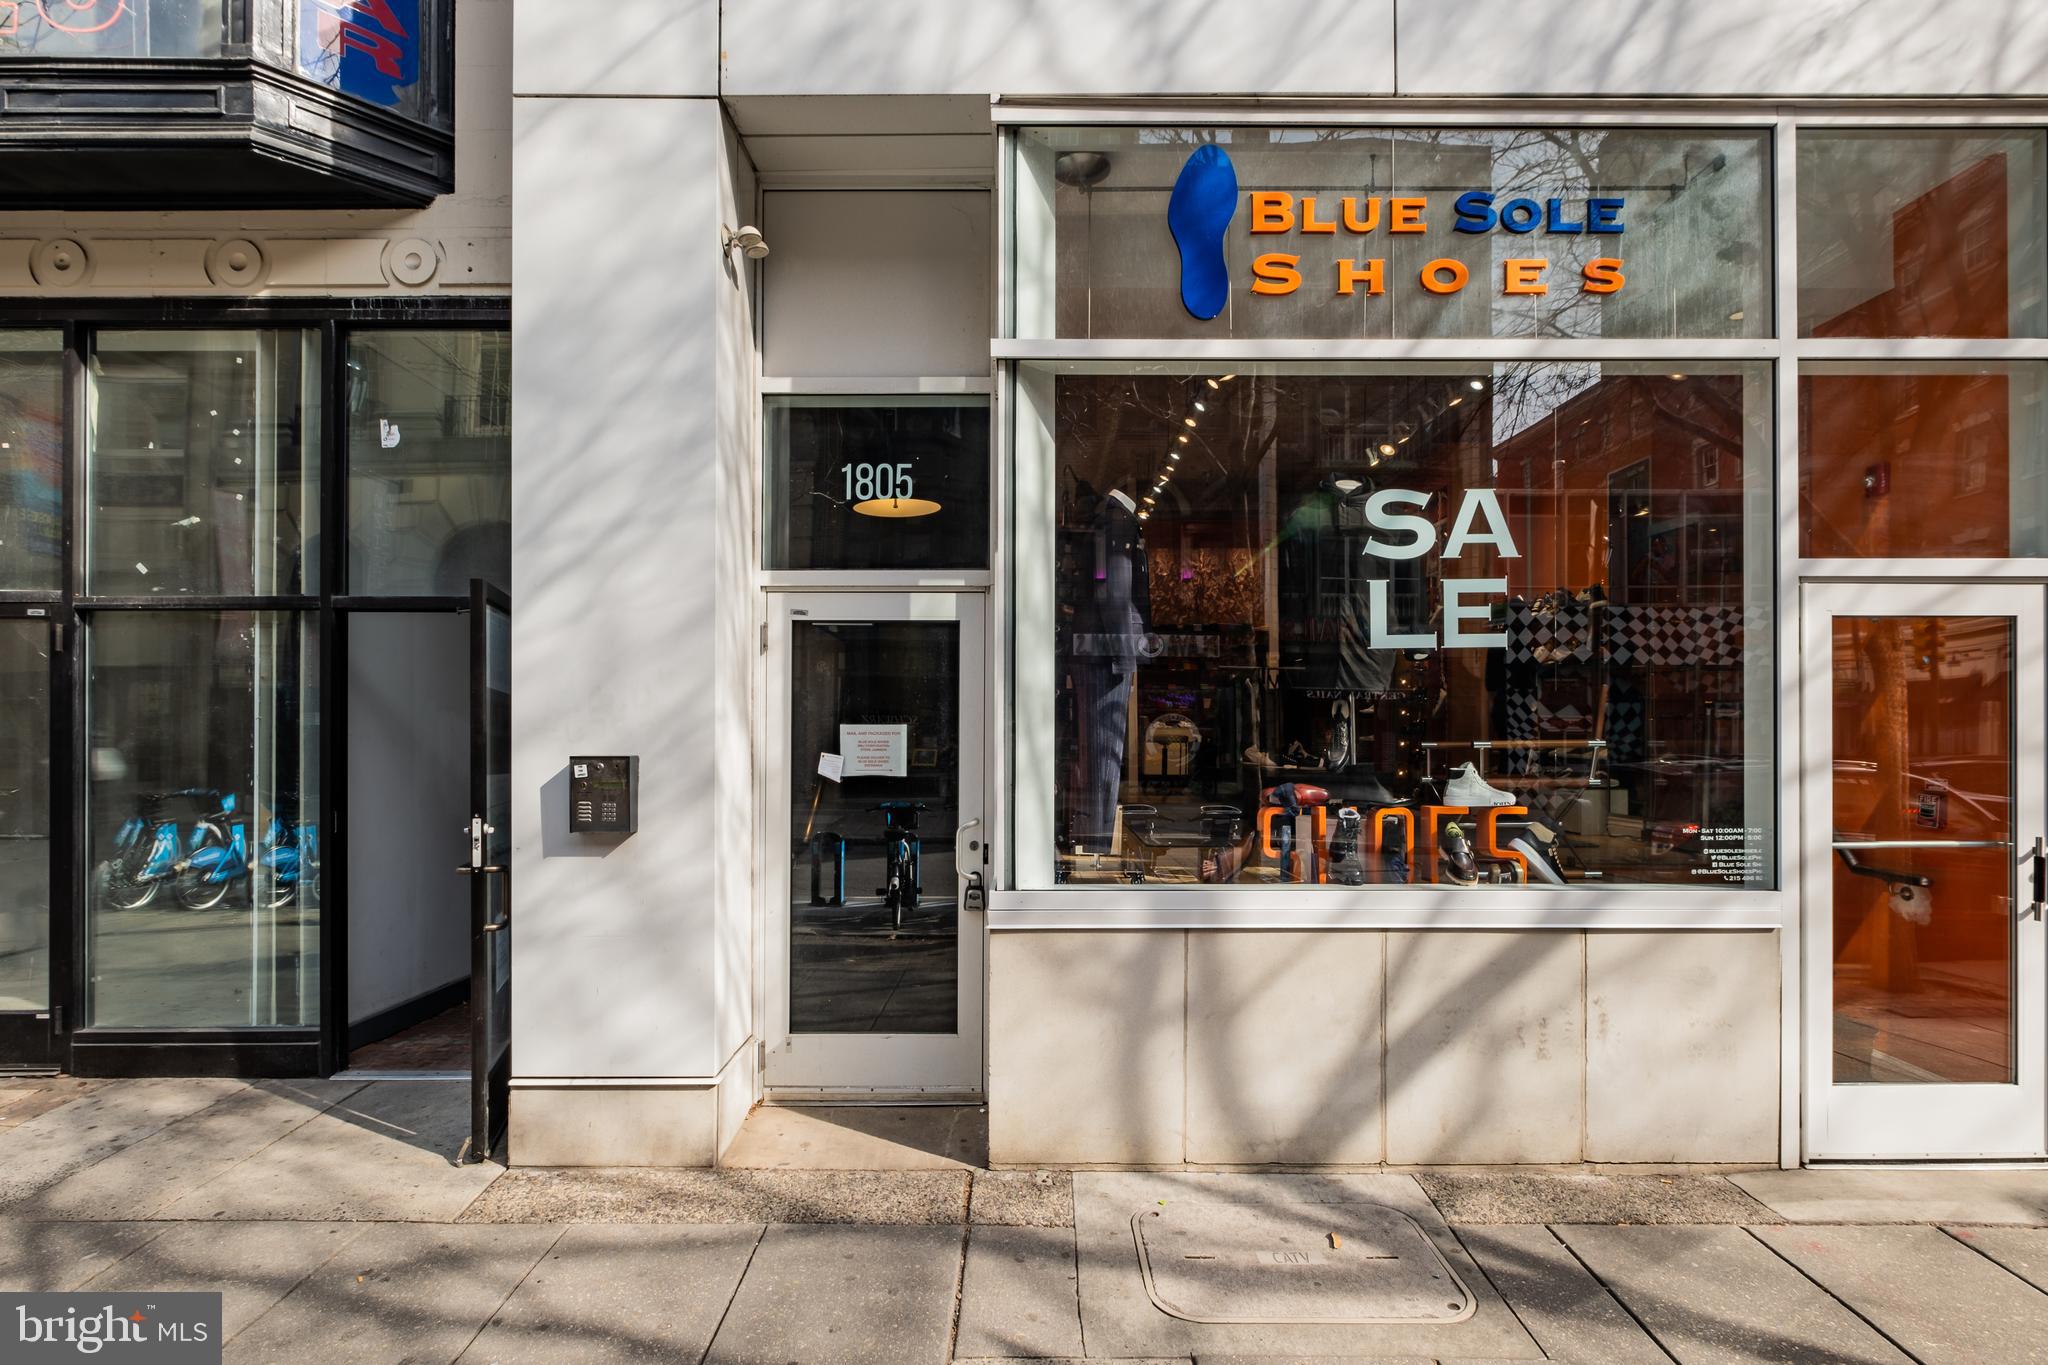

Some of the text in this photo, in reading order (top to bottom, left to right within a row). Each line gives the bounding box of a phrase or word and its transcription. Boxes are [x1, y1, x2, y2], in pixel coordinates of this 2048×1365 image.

[1249, 191, 1625, 235] BLUE SOLE
[1250, 252, 1626, 296] SHOES
[841, 463, 913, 500] 1805
[1272, 1252, 1310, 1263] CATV
